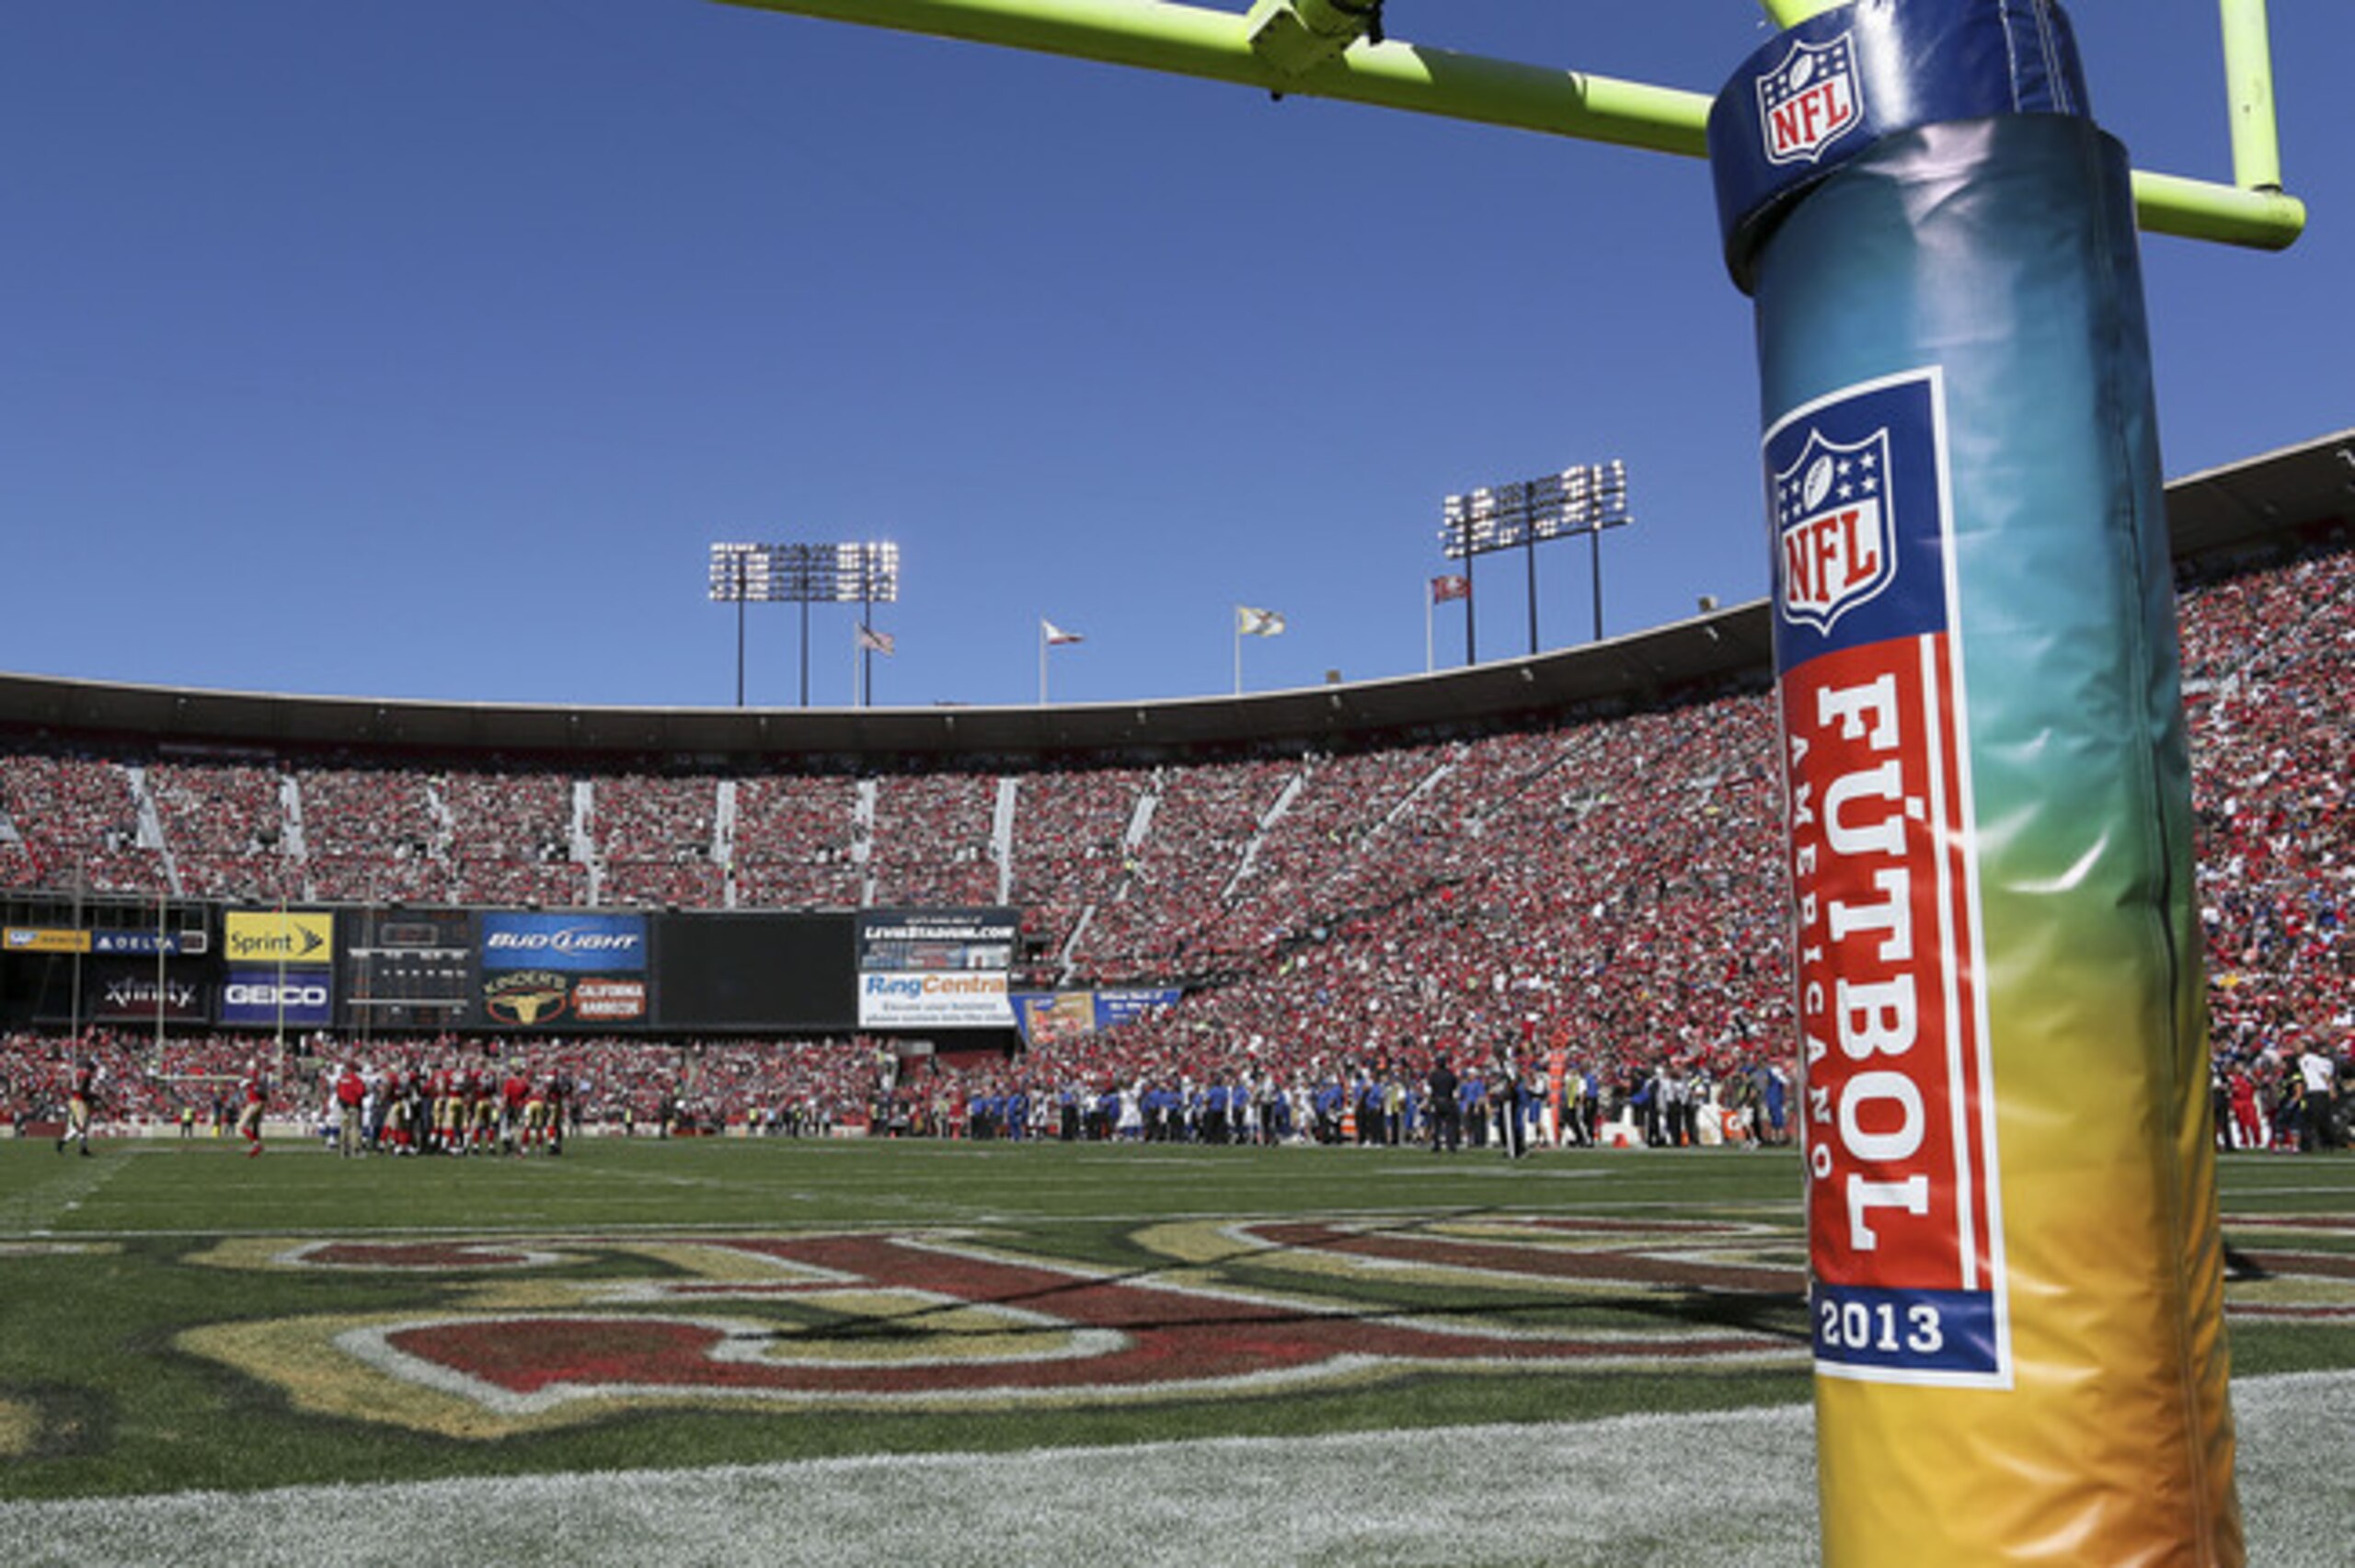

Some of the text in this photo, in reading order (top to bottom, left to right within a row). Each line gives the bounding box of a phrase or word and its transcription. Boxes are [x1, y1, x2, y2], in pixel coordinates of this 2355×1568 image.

[1769, 74, 1850, 150] NFL
[1785, 509, 1878, 602] NFL
[116, 937, 175, 950] DELTA
[231, 931, 293, 954] Sprint
[488, 933, 639, 949] BUD LIGHT
[1789, 735, 1832, 1178] AMERICANO
[1817, 673, 1930, 1252] FÚTBOL
[104, 977, 195, 1008] xfinty
[224, 984, 327, 1005] GEICO
[866, 974, 1006, 997] RingCentra
[1821, 1299, 1944, 1353] 2013
